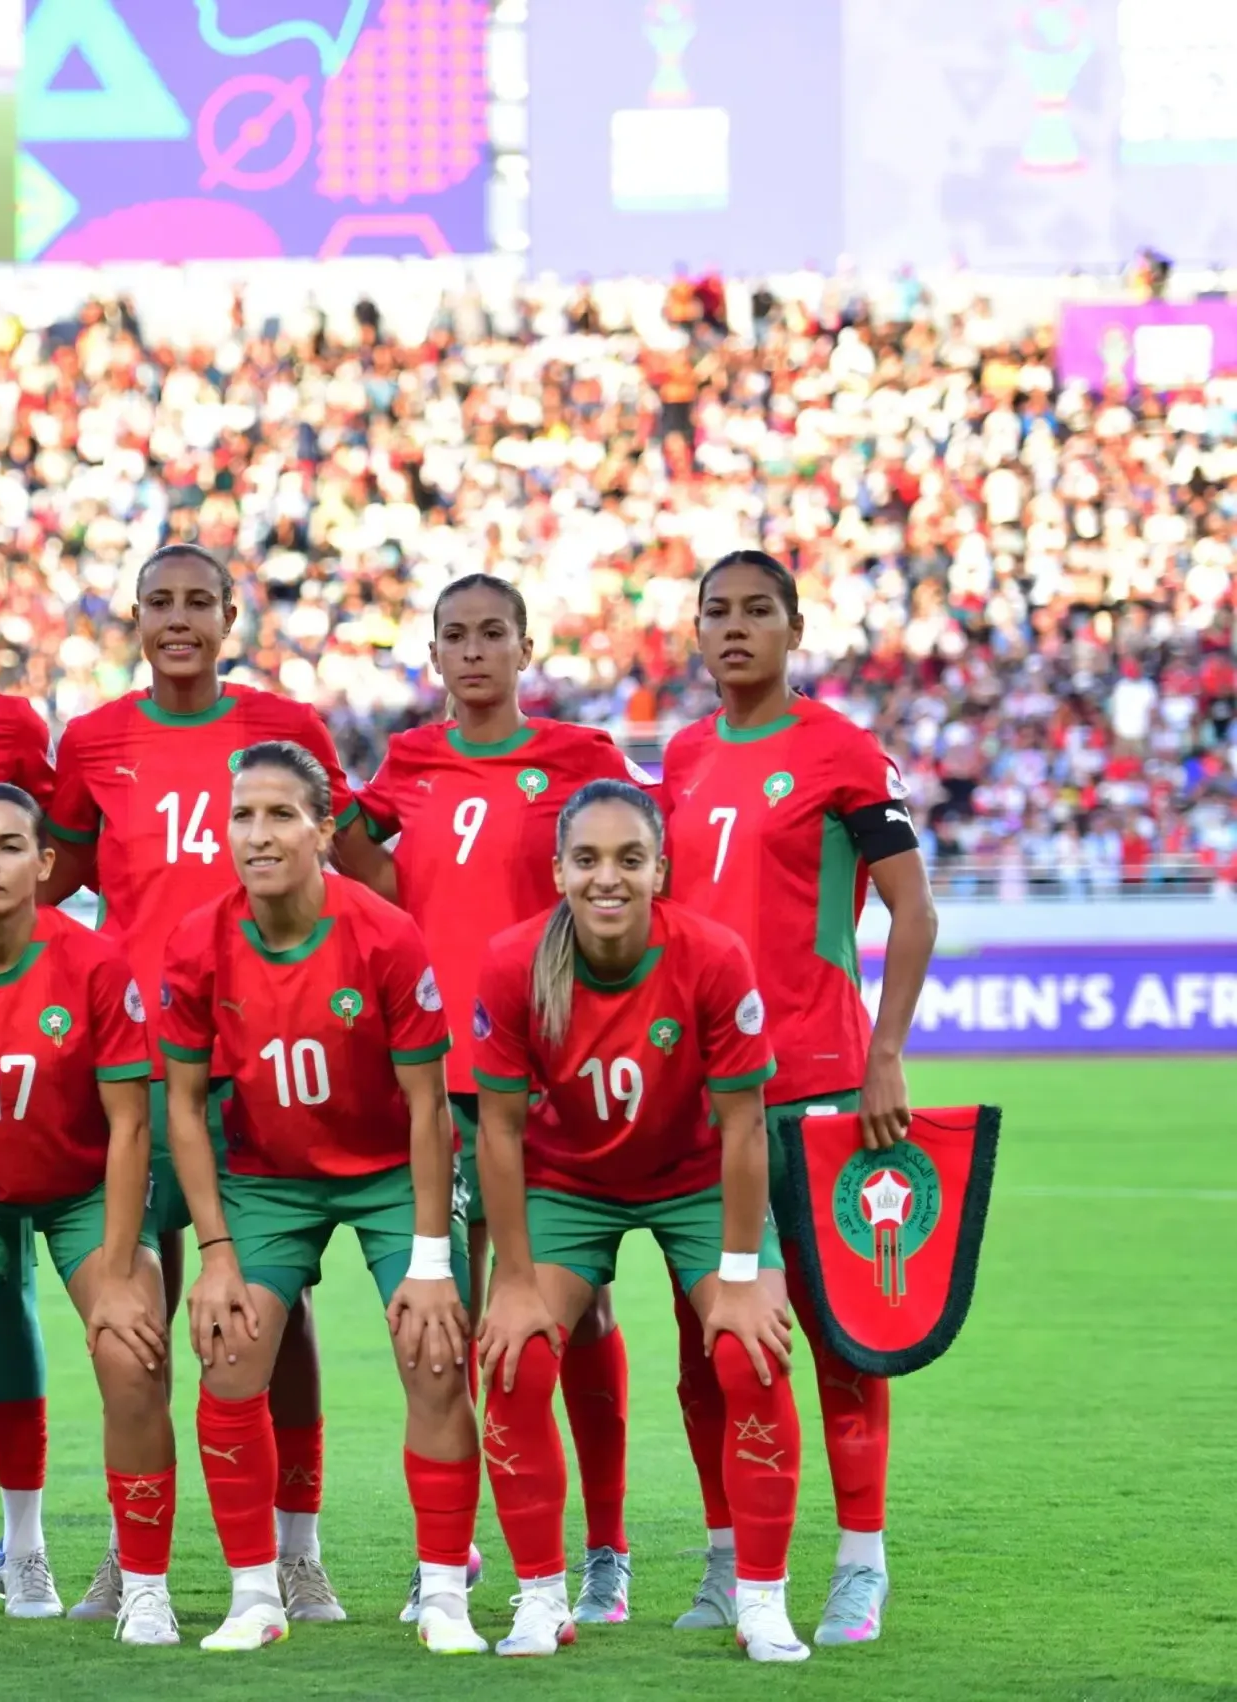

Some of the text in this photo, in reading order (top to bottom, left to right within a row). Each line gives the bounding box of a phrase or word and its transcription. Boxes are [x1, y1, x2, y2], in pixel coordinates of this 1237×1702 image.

[155, 790, 221, 865] 14
[452, 796, 488, 865] 9
[708, 807, 738, 883] 7
[861, 973, 1115, 1031] MEN'S
[259, 1038, 331, 1108] 10
[578, 1056, 644, 1122] 19
